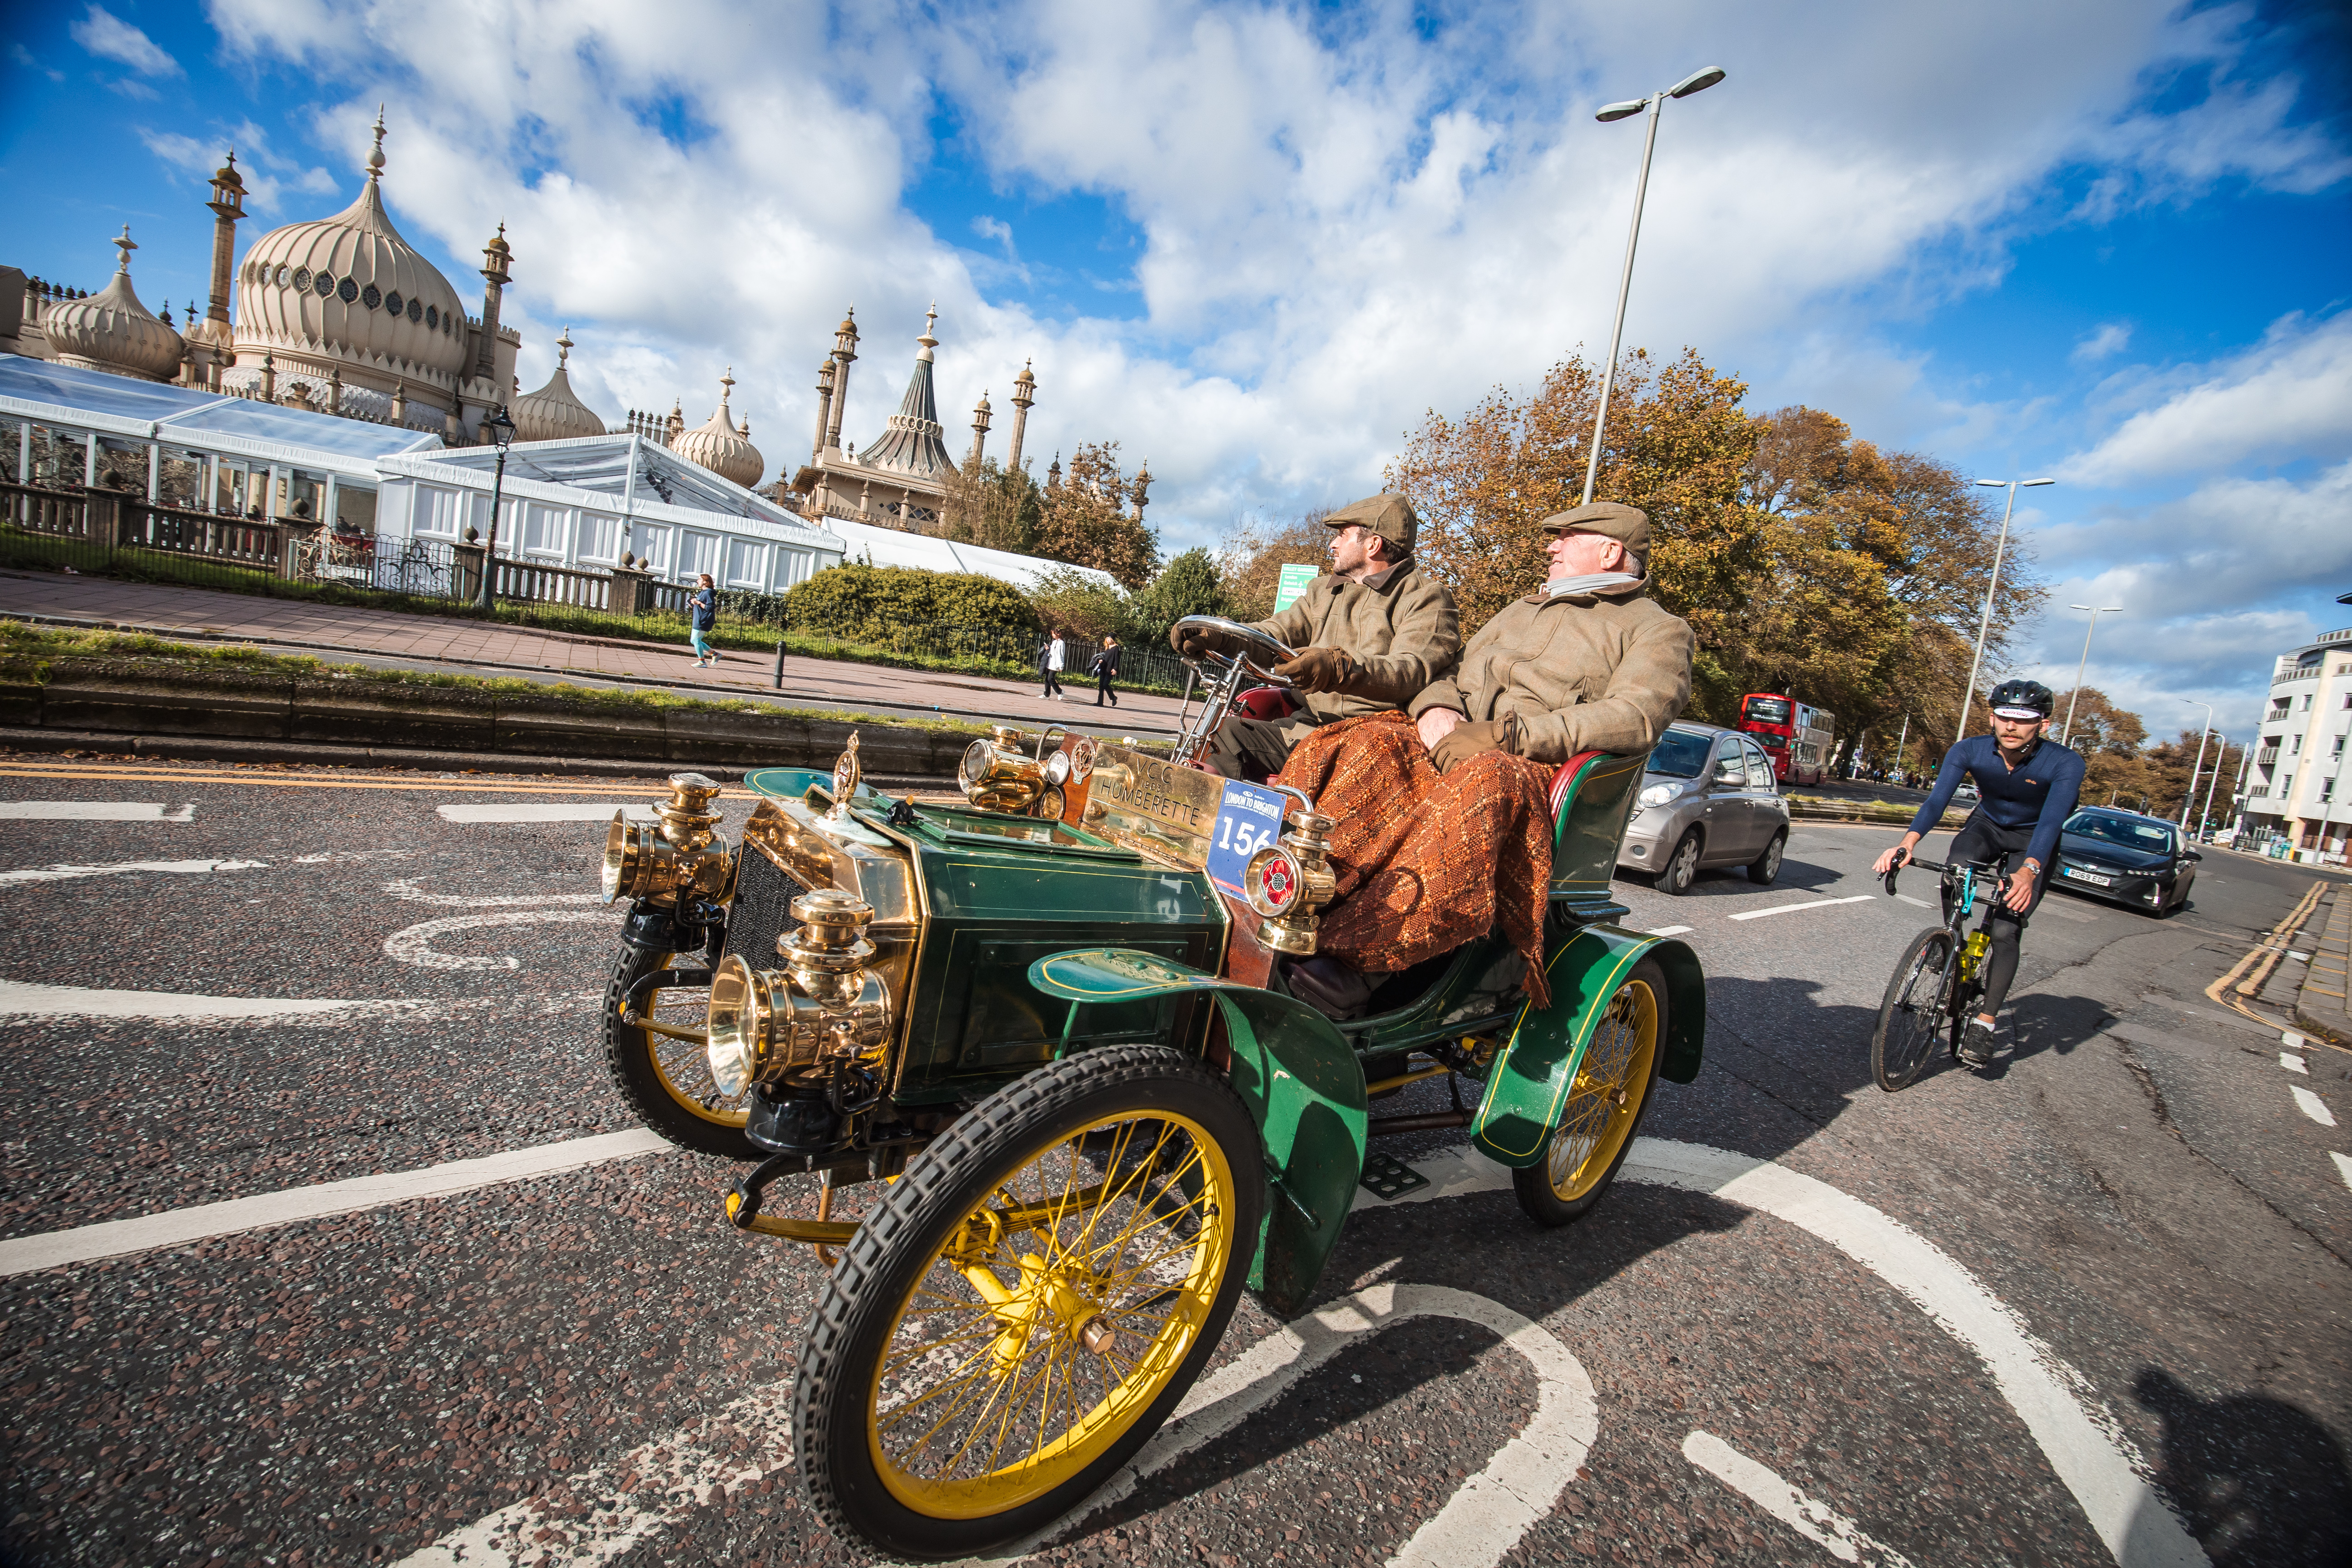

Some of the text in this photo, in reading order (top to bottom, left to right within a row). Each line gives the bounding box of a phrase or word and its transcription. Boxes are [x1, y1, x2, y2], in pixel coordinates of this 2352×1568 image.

[1100, 778, 1200, 827] HUMBERETTE
[1140, 779, 1161, 793] 1903
[1224, 791, 1246, 806] LONDON
[1246, 797, 1253, 808] TO
[1252, 799, 1280, 820] BRIGHTON
[1218, 816, 1271, 856] 156
